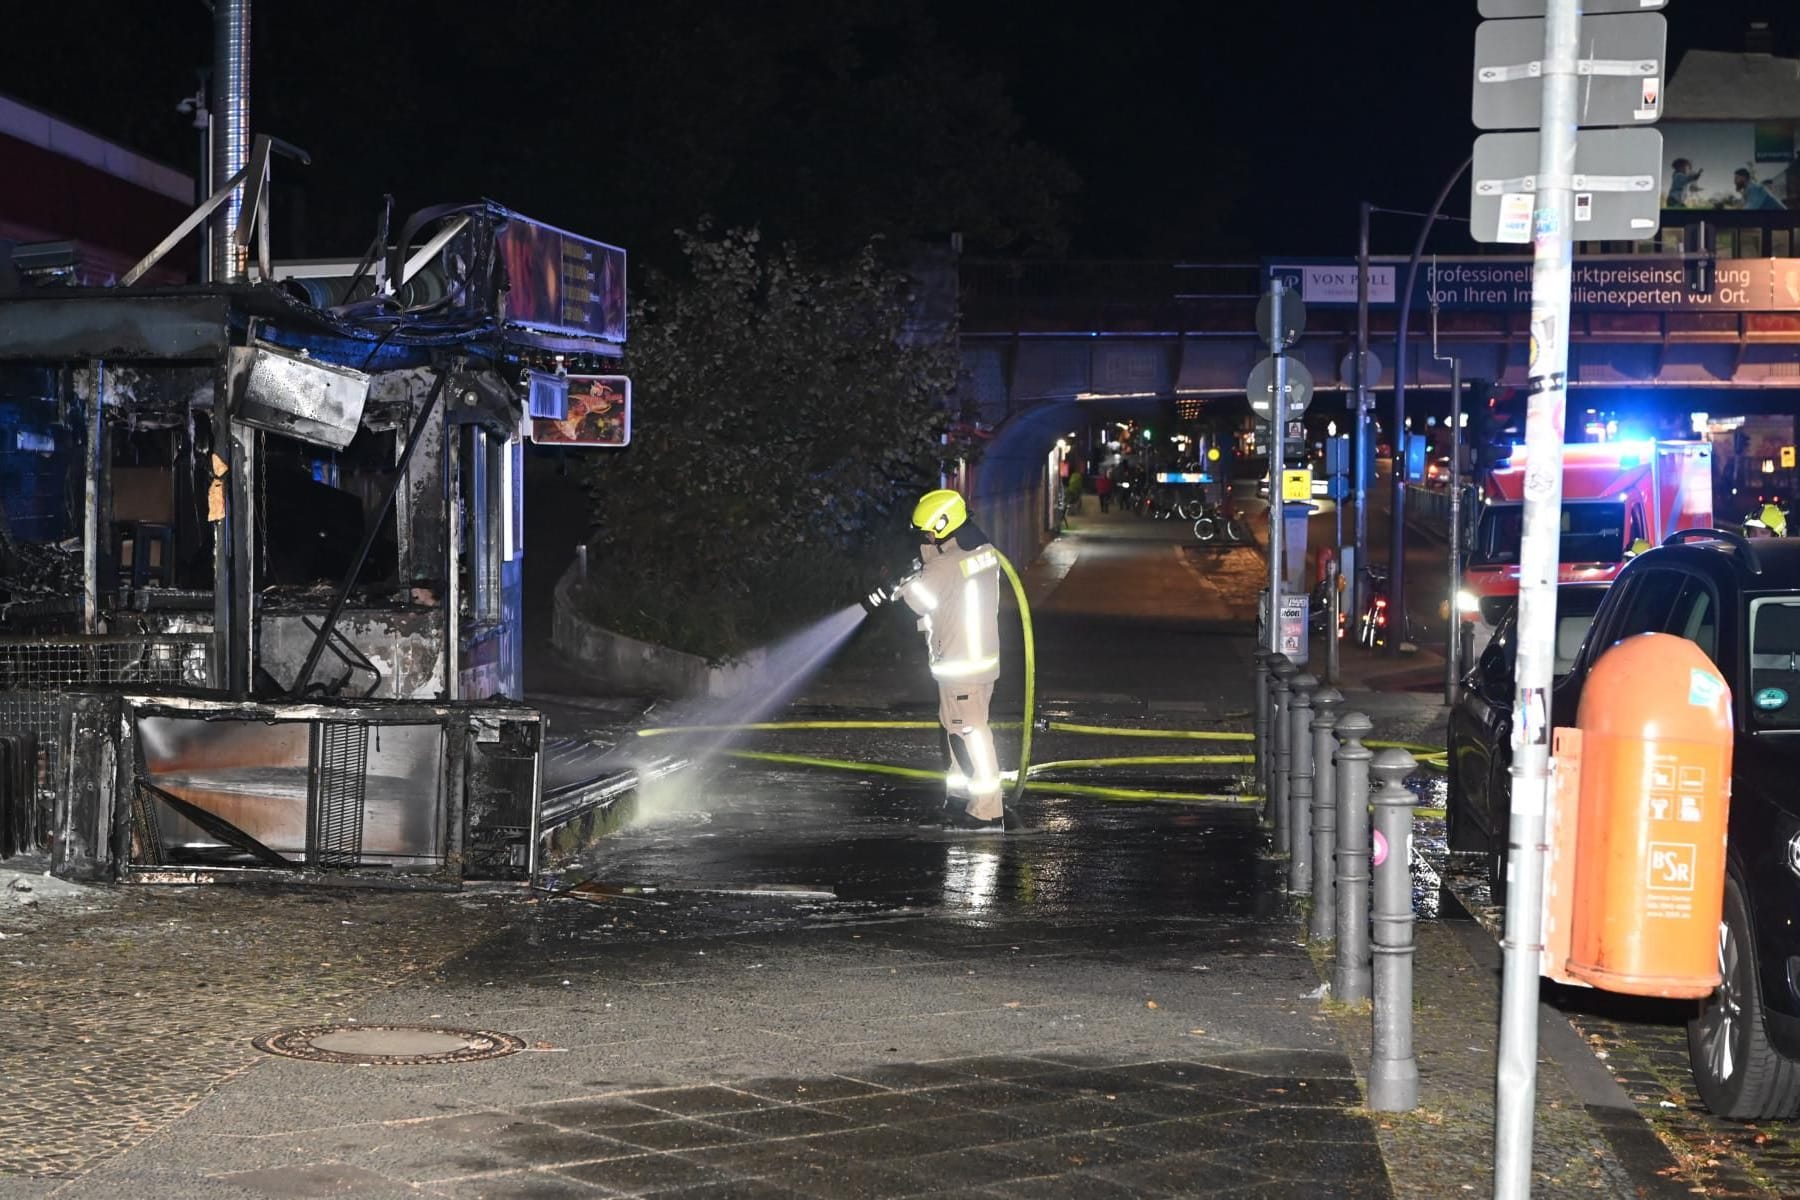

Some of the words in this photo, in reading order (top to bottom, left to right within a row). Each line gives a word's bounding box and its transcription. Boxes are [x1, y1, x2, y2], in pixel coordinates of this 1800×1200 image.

[1312, 273, 1345, 285] VON
[1351, 274, 1390, 286] PLL
[1427, 265, 1534, 283] Professionell
[1426, 290, 1458, 303] von
[1464, 286, 1507, 303] Ihren
[1513, 286, 1681, 307] Imilienexperten
[1720, 287, 1750, 303] Ort.
[1653, 850, 1690, 883] BSR
